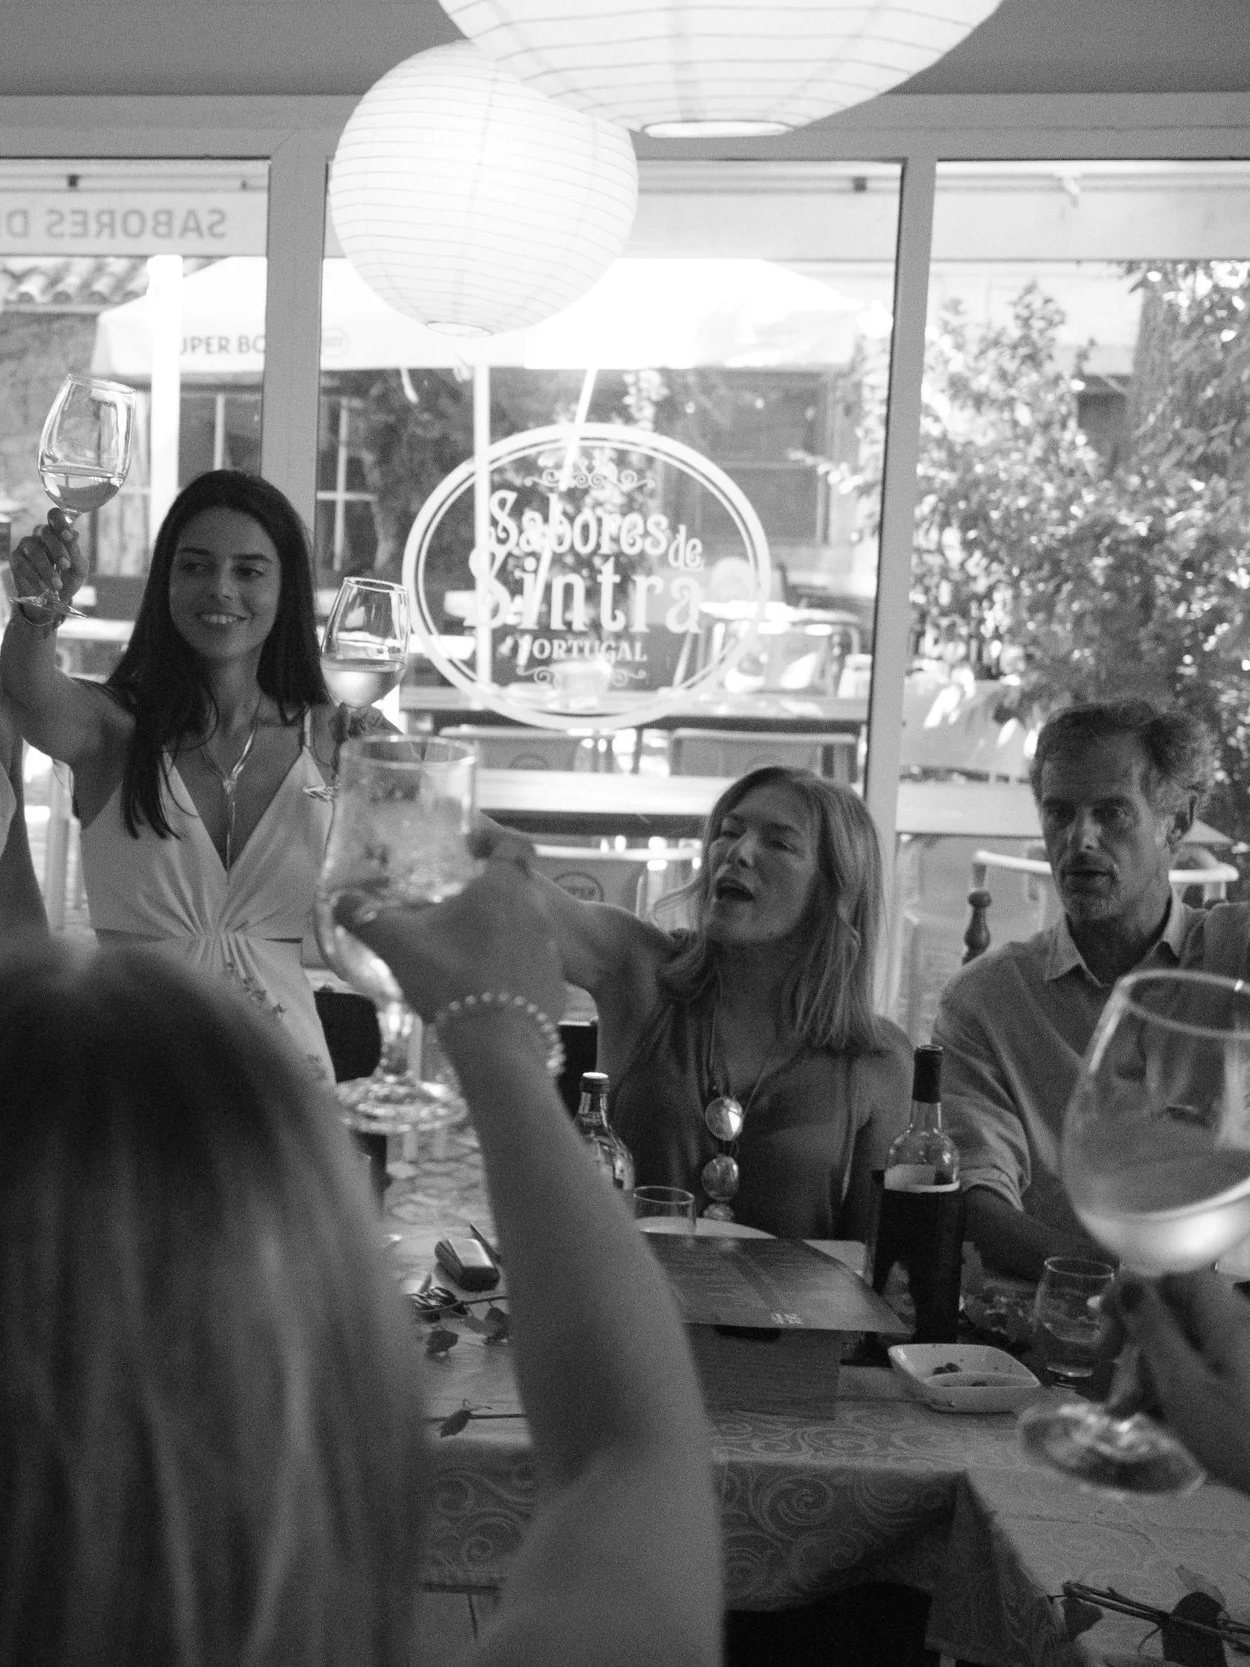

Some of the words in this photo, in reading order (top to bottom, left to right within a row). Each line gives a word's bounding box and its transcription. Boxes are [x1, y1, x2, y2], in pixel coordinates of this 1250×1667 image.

[180, 335, 231, 356] UPER
[237, 334, 266, 355] BO
[487, 489, 669, 555] Sabores
[668, 524, 706, 570] de
[463, 545, 703, 633] Sintra
